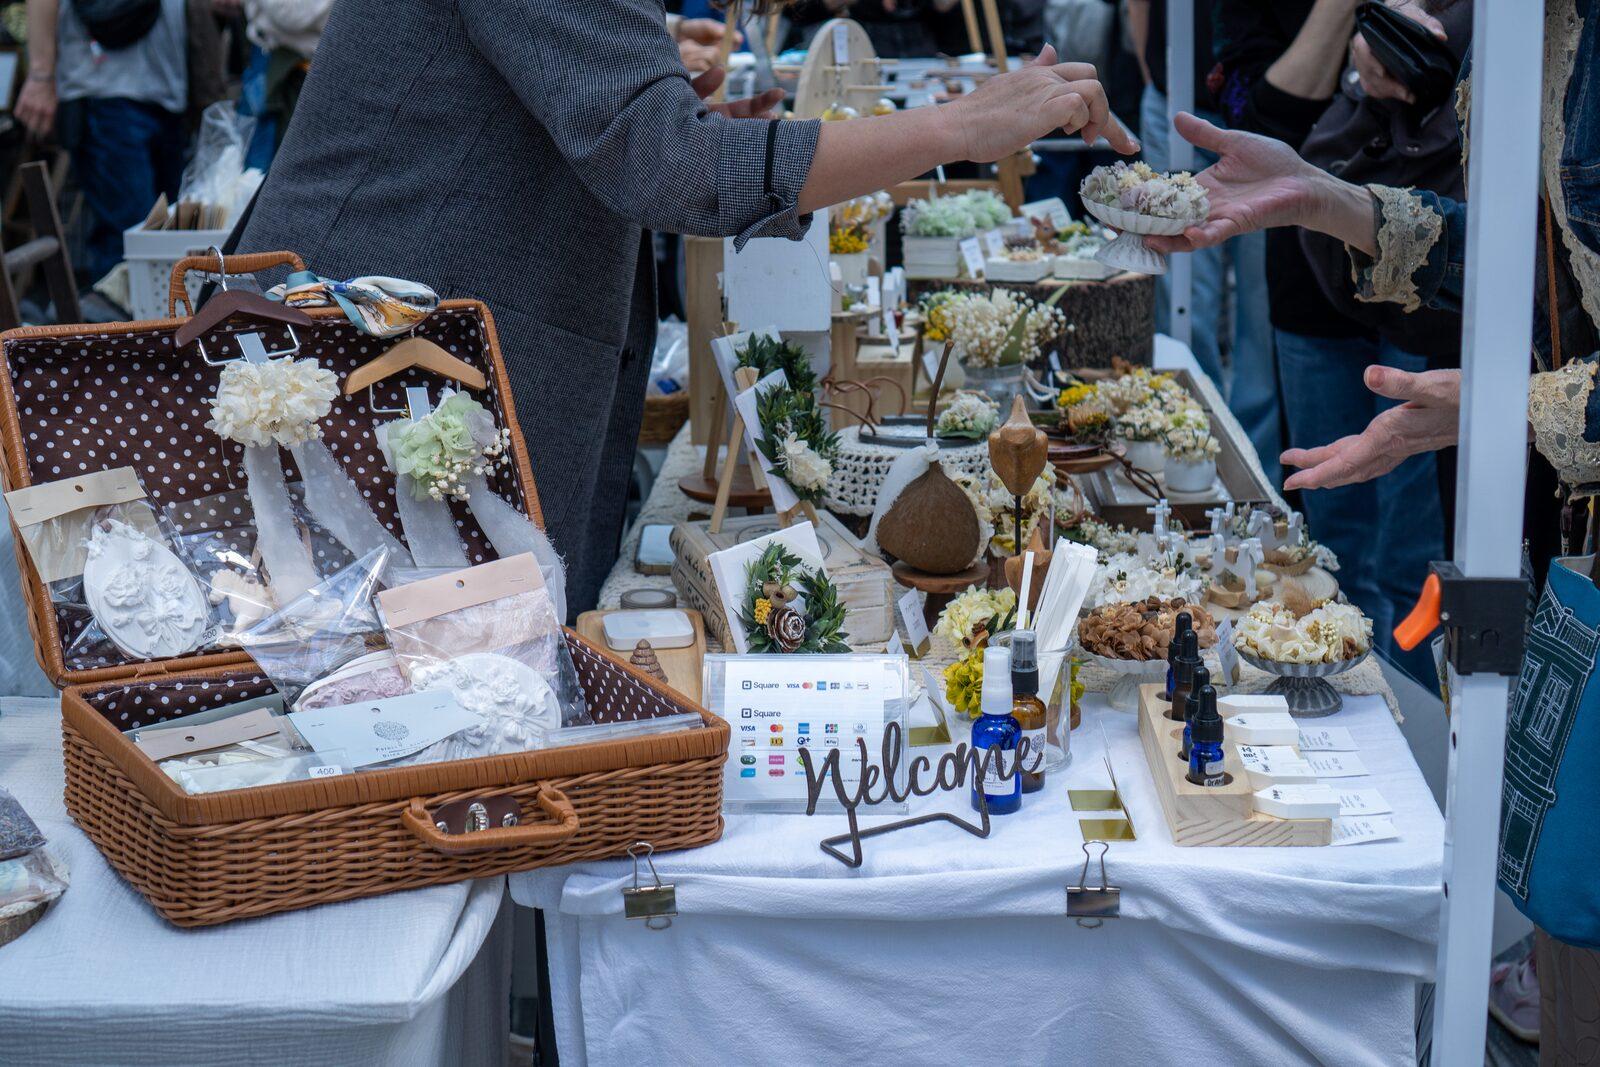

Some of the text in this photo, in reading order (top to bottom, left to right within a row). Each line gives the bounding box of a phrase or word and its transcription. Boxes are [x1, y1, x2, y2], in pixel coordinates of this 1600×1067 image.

[202, 628, 217, 640] 500
[753, 681, 780, 690] Square
[753, 709, 782, 719] Square
[317, 767, 335, 775] 400
[797, 721, 1043, 816] Welcome
